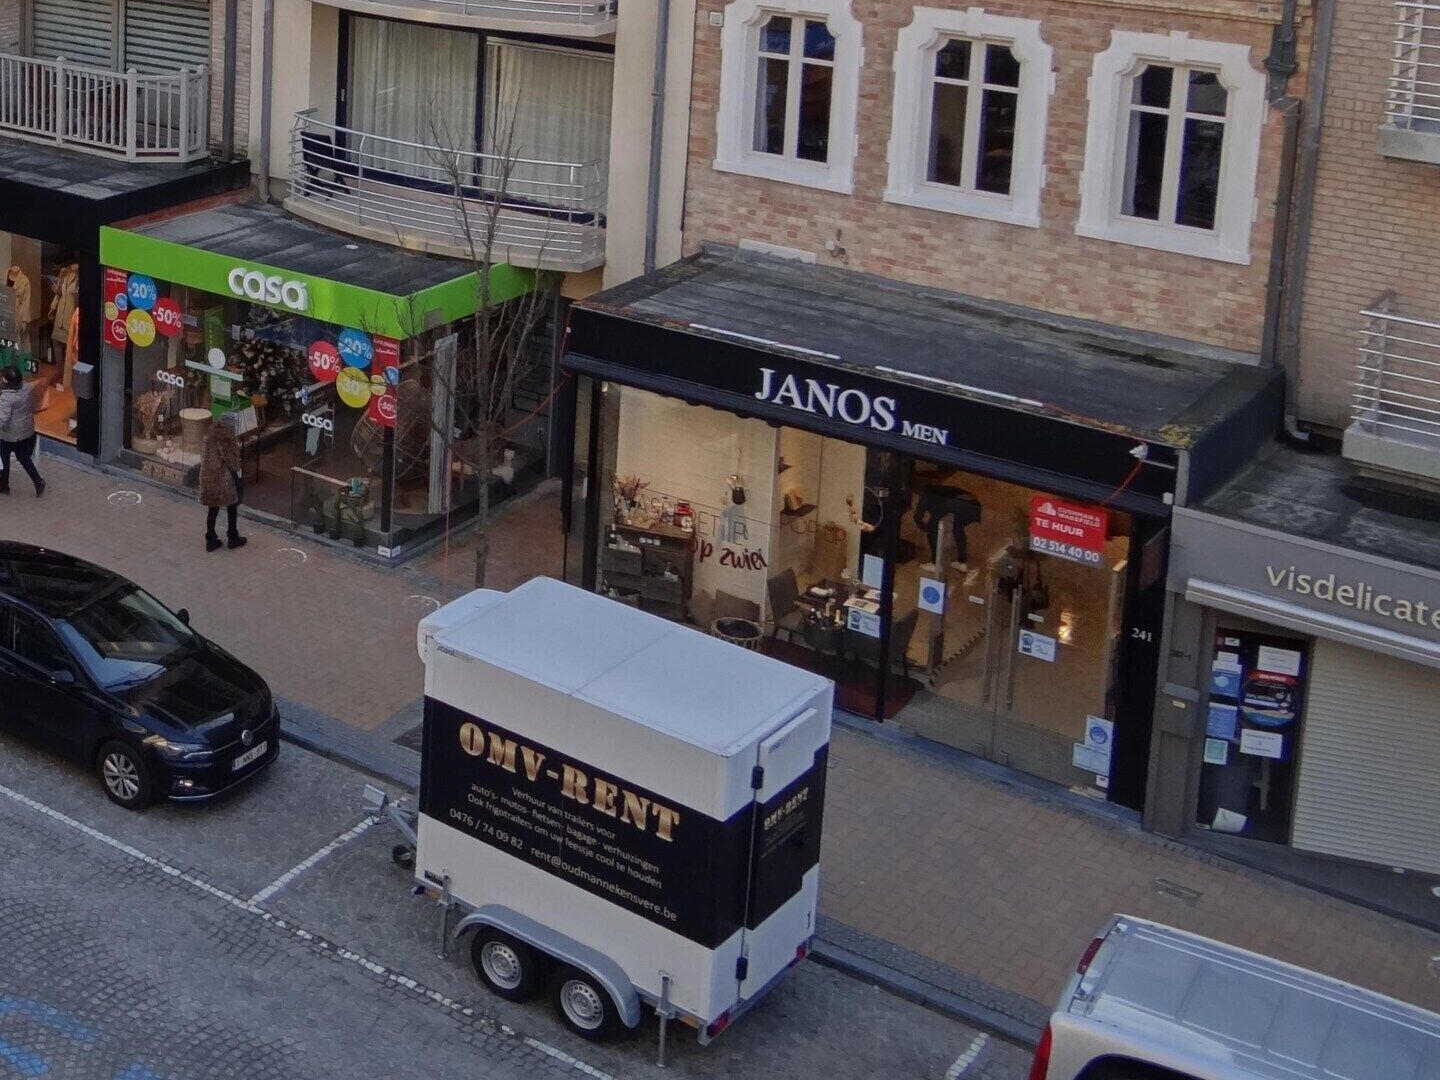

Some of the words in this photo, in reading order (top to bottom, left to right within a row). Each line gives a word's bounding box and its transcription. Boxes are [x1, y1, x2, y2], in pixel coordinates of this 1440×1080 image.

[128, 281, 157, 300] -20%
[228, 267, 308, 311] casa
[152, 307, 182, 328] -50%
[308, 351, 341, 373] -50%
[156, 369, 185, 388] casa
[755, 367, 896, 432] JANOS
[901, 420, 949, 446] MEN
[301, 413, 333, 431] casa
[1035, 517, 1049, 528] TE
[1051, 521, 1084, 537] HUUR
[1033, 536, 1047, 549] 02
[1048, 540, 1066, 554] 514
[1068, 546, 1082, 558] 40
[1084, 550, 1099, 562] 00
[1131, 627, 1153, 642] 241
[460, 722, 681, 843] OMV-RENT
[511, 787, 547, 808] Verhuur
[547, 804, 563, 817] van
[564, 810, 595, 831] trailers
[596, 826, 617, 840] voor
[449, 807, 474, 827] 0476
[482, 822, 494, 836] 74
[496, 829, 509, 843] 09
[510, 836, 523, 850] 82
[467, 793, 484, 808] Ook
[485, 801, 534, 830] frigotrailers
[534, 825, 549, 837] om
[549, 831, 564, 844] uw
[565, 837, 594, 859] feestje
[595, 852, 615, 867] cool
[616, 861, 626, 873] te
[627, 864, 662, 890] houden
[602, 842, 660, 875] verhuizingen
